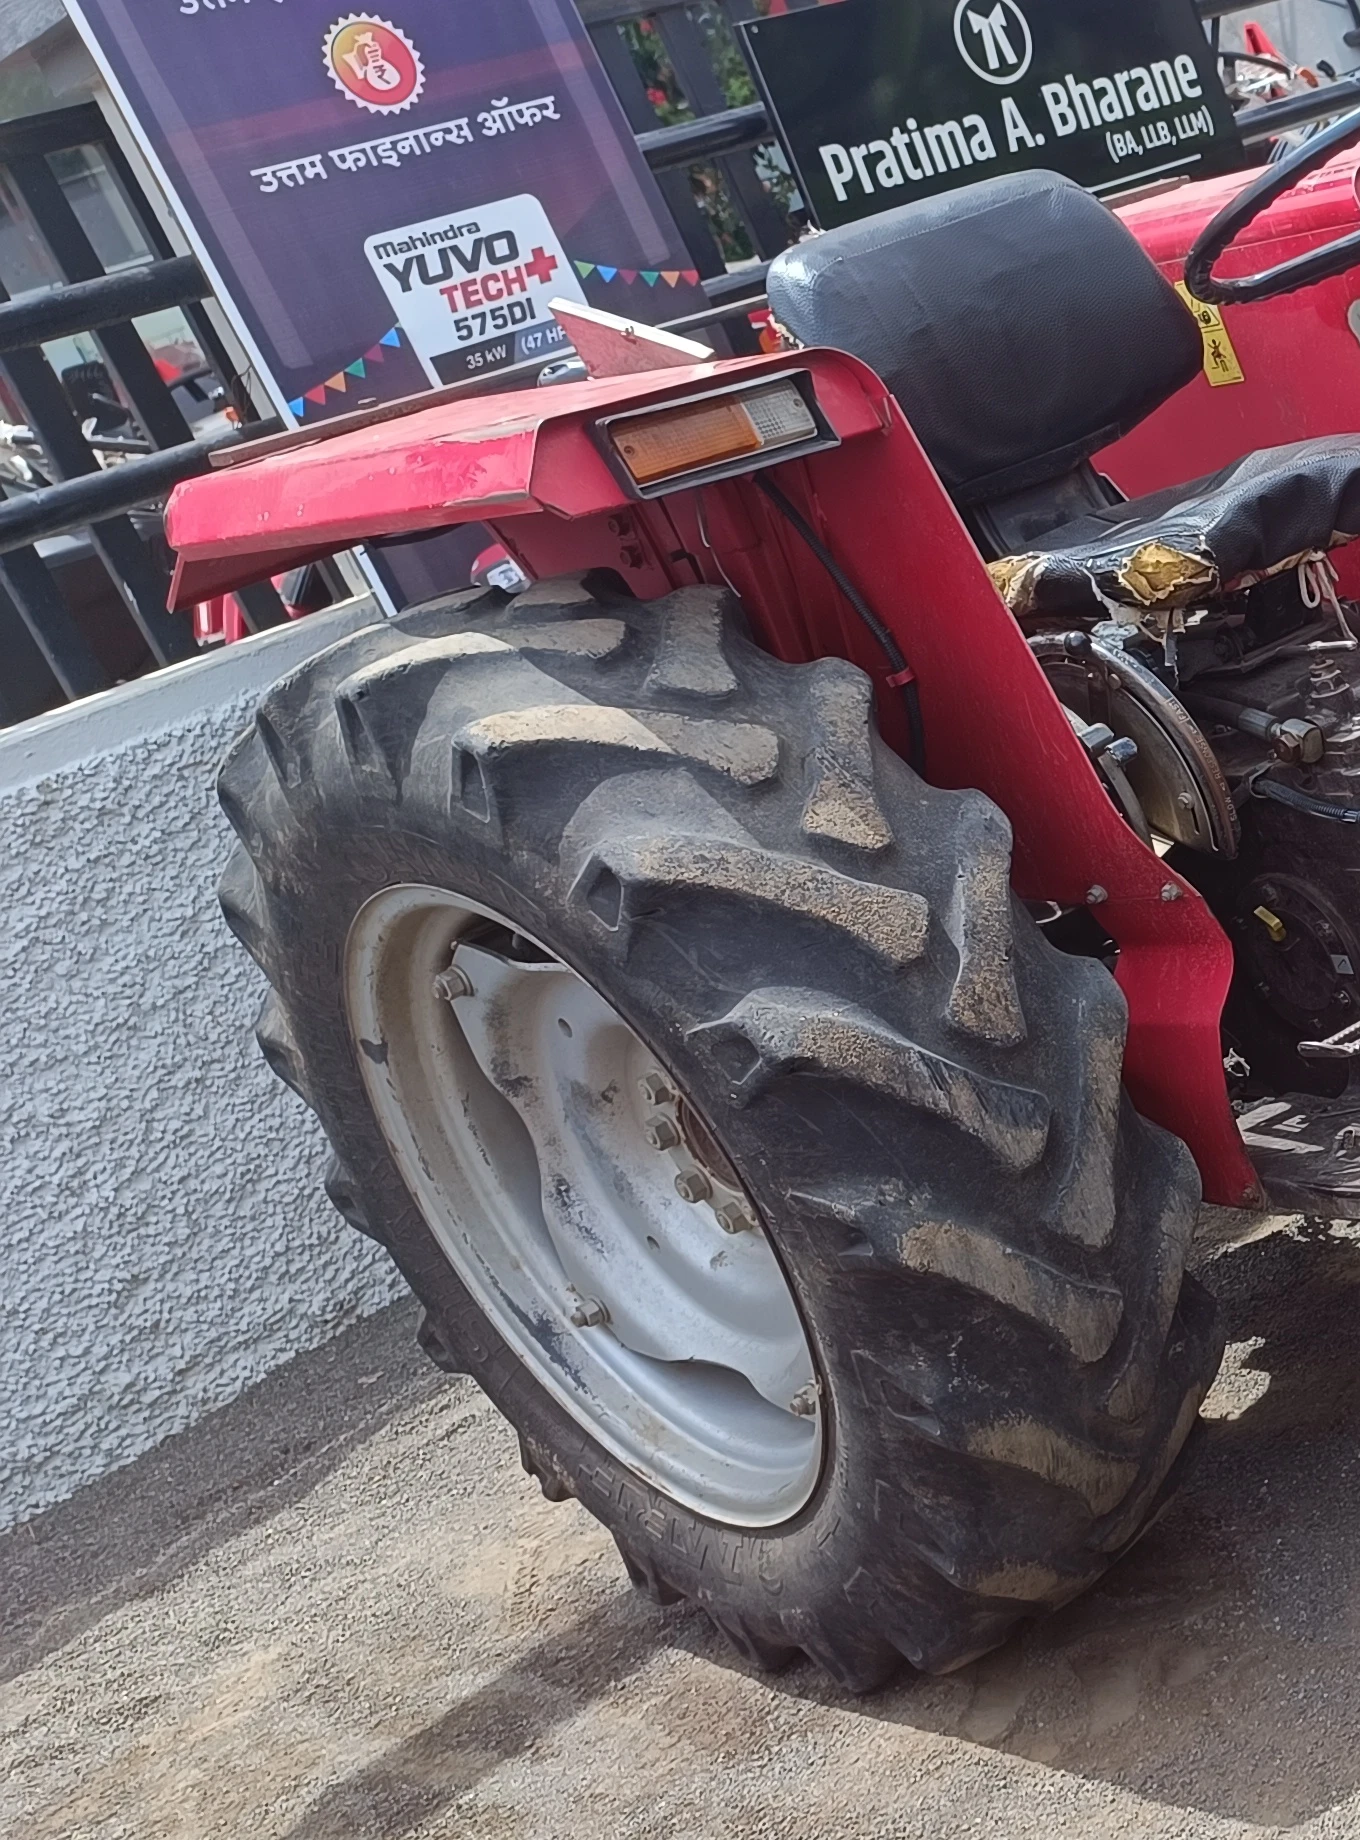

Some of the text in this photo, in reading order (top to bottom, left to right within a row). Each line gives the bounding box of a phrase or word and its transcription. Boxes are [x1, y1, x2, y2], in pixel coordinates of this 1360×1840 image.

[250, 96, 562, 193] उत्तम फाइनान्स ऑफर
[818, 54, 1203, 202] Pratima A. Bharane
[1105, 104, 1215, 164] (BA, LLB, LLM)
[373, 221, 481, 260] Mahindra
[383, 229, 520, 293] YUVO
[453, 297, 537, 342] 575DI
[466, 352, 484, 370] 35
[485, 344, 507, 364] kW
[521, 332, 542, 355] (47
